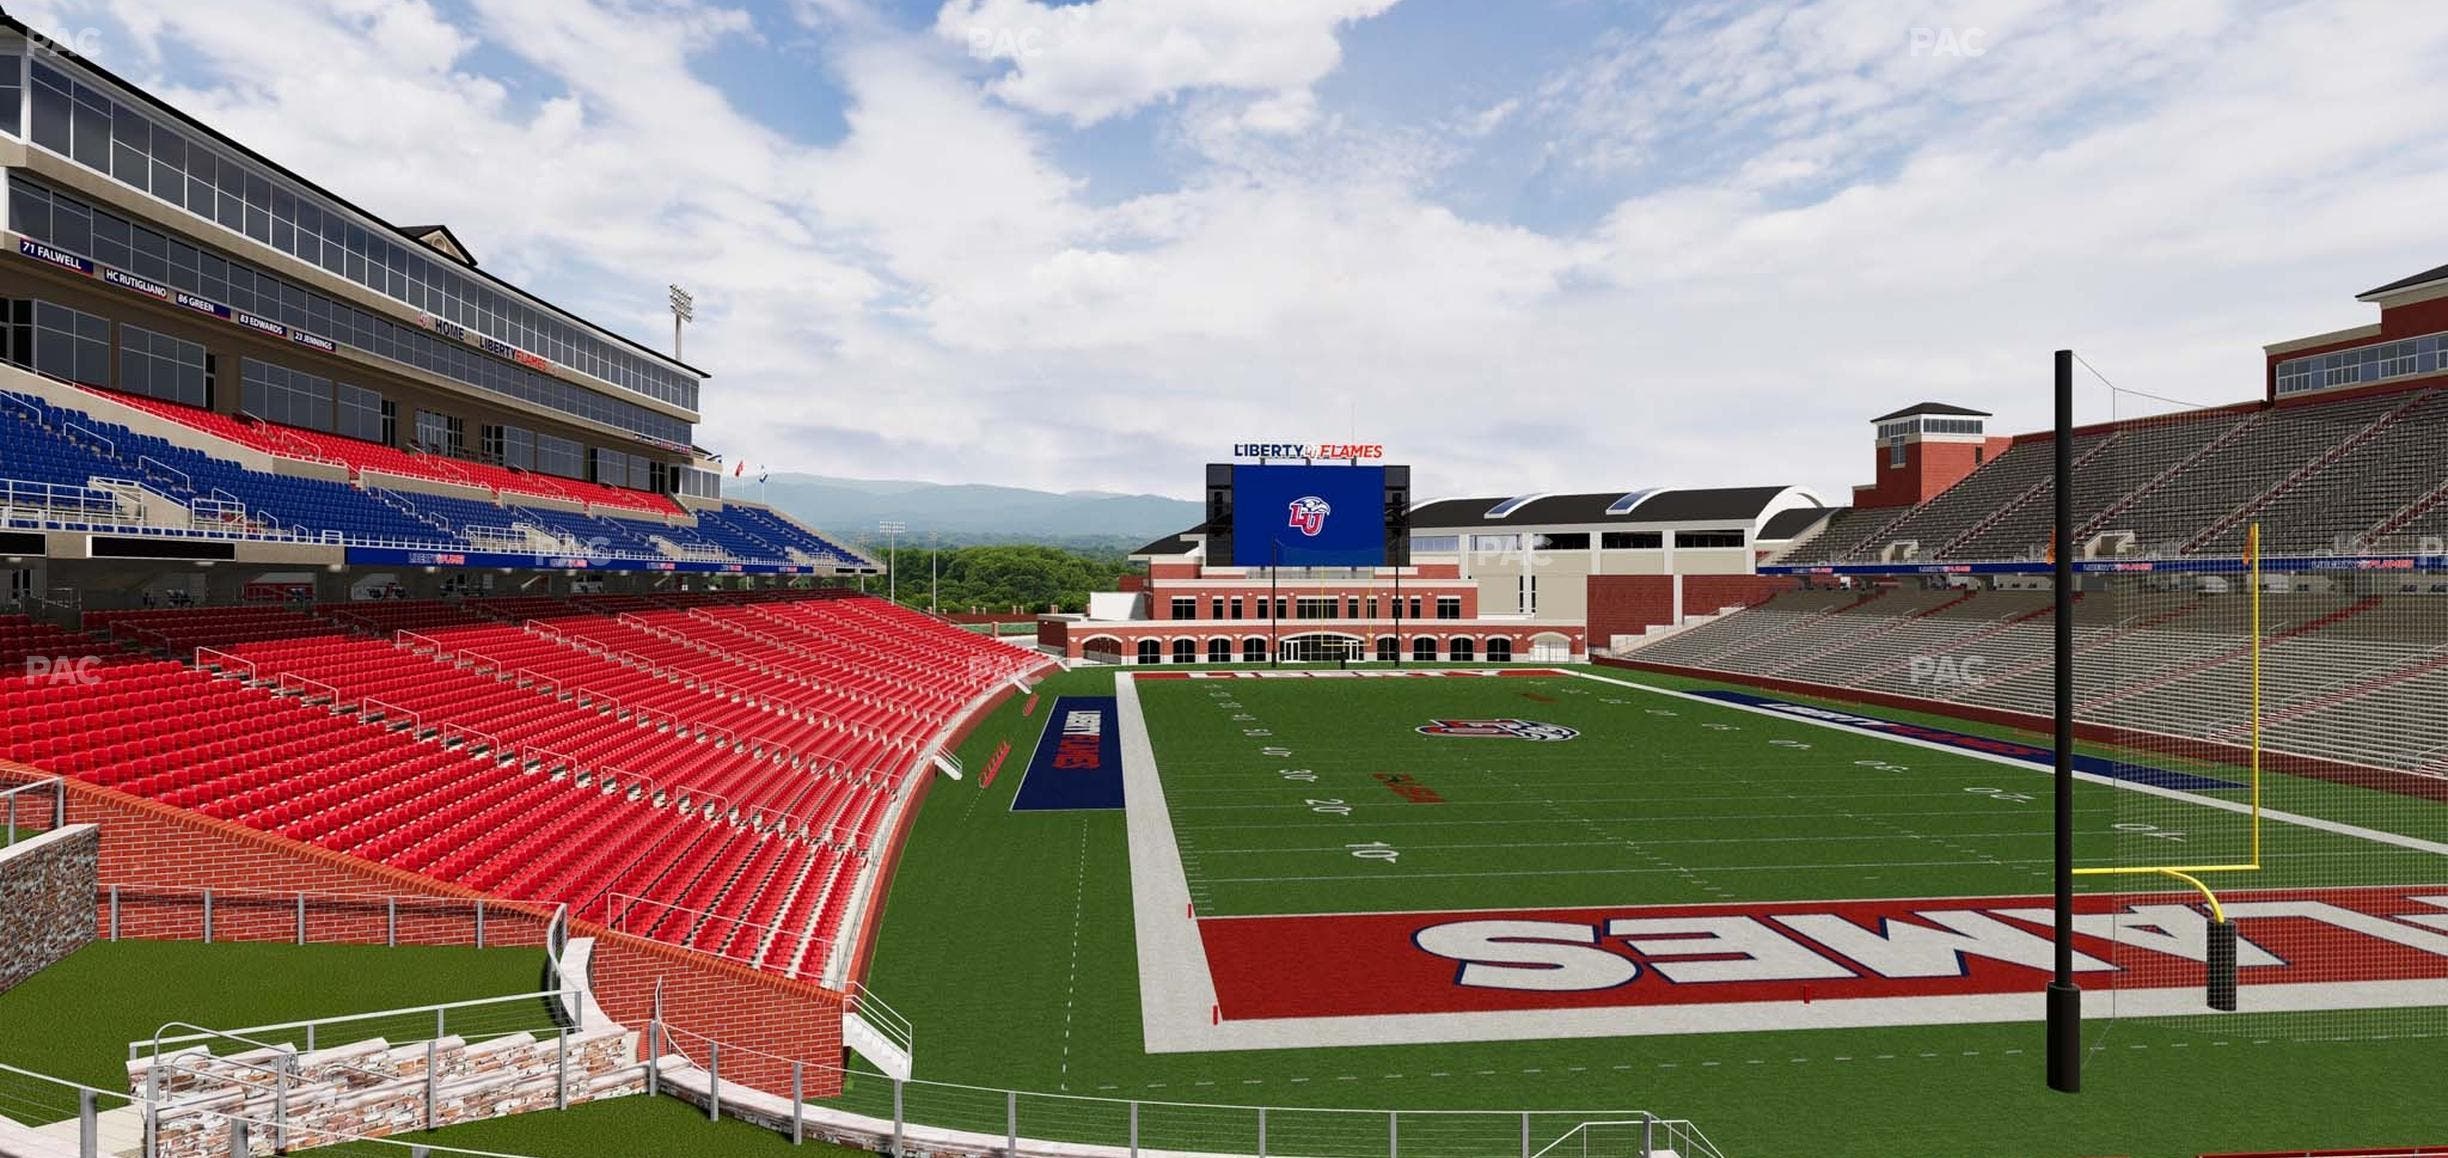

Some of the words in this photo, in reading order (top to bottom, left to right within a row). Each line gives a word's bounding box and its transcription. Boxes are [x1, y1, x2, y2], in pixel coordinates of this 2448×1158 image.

[23, 241, 35, 254] 71
[38, 246, 82, 270] FALWELL
[106, 269, 119, 282] HC
[119, 273, 167, 298] RUTIGLIANO
[189, 297, 214, 313] GREEN
[250, 316, 283, 335] EDWARDS
[303, 333, 333, 351] JENNINGS
[435, 319, 465, 341] HOME
[479, 335, 516, 360] LIBERTY
[1234, 443, 1303, 457] LIBERTY
[1319, 444, 1383, 458] FLAMES
[1289, 503, 1326, 536] LU
[1305, 799, 1353, 815] 20
[1345, 841, 1399, 864] 10
